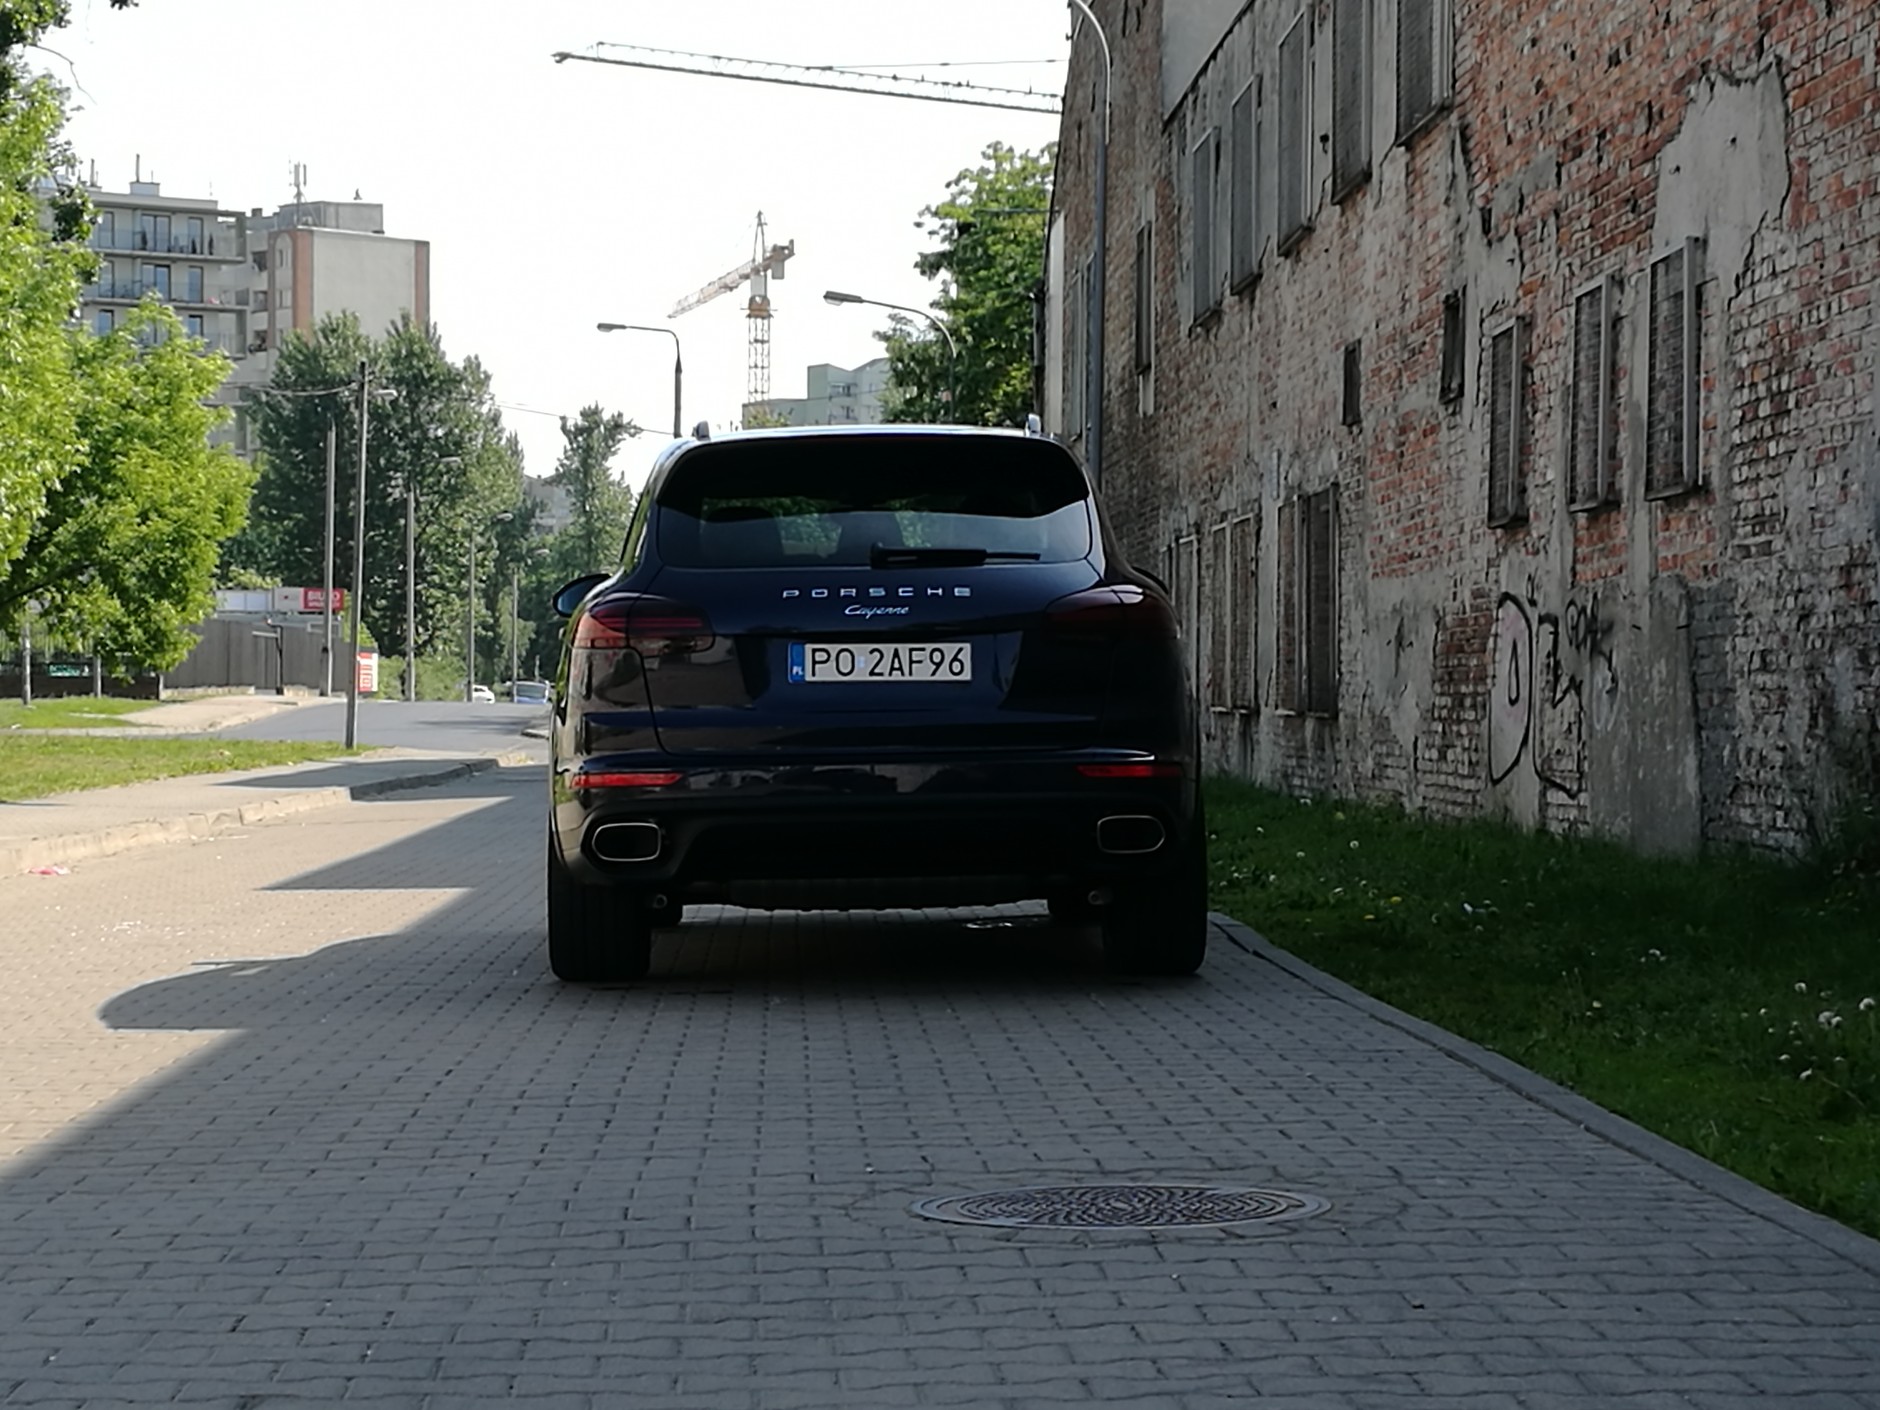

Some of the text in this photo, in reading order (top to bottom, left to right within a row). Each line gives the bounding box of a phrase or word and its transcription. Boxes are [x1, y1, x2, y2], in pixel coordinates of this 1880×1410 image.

[783, 587, 971, 598] PORSCHE
[845, 604, 909, 619] Cayenne
[811, 647, 965, 677] PO 2AF96
